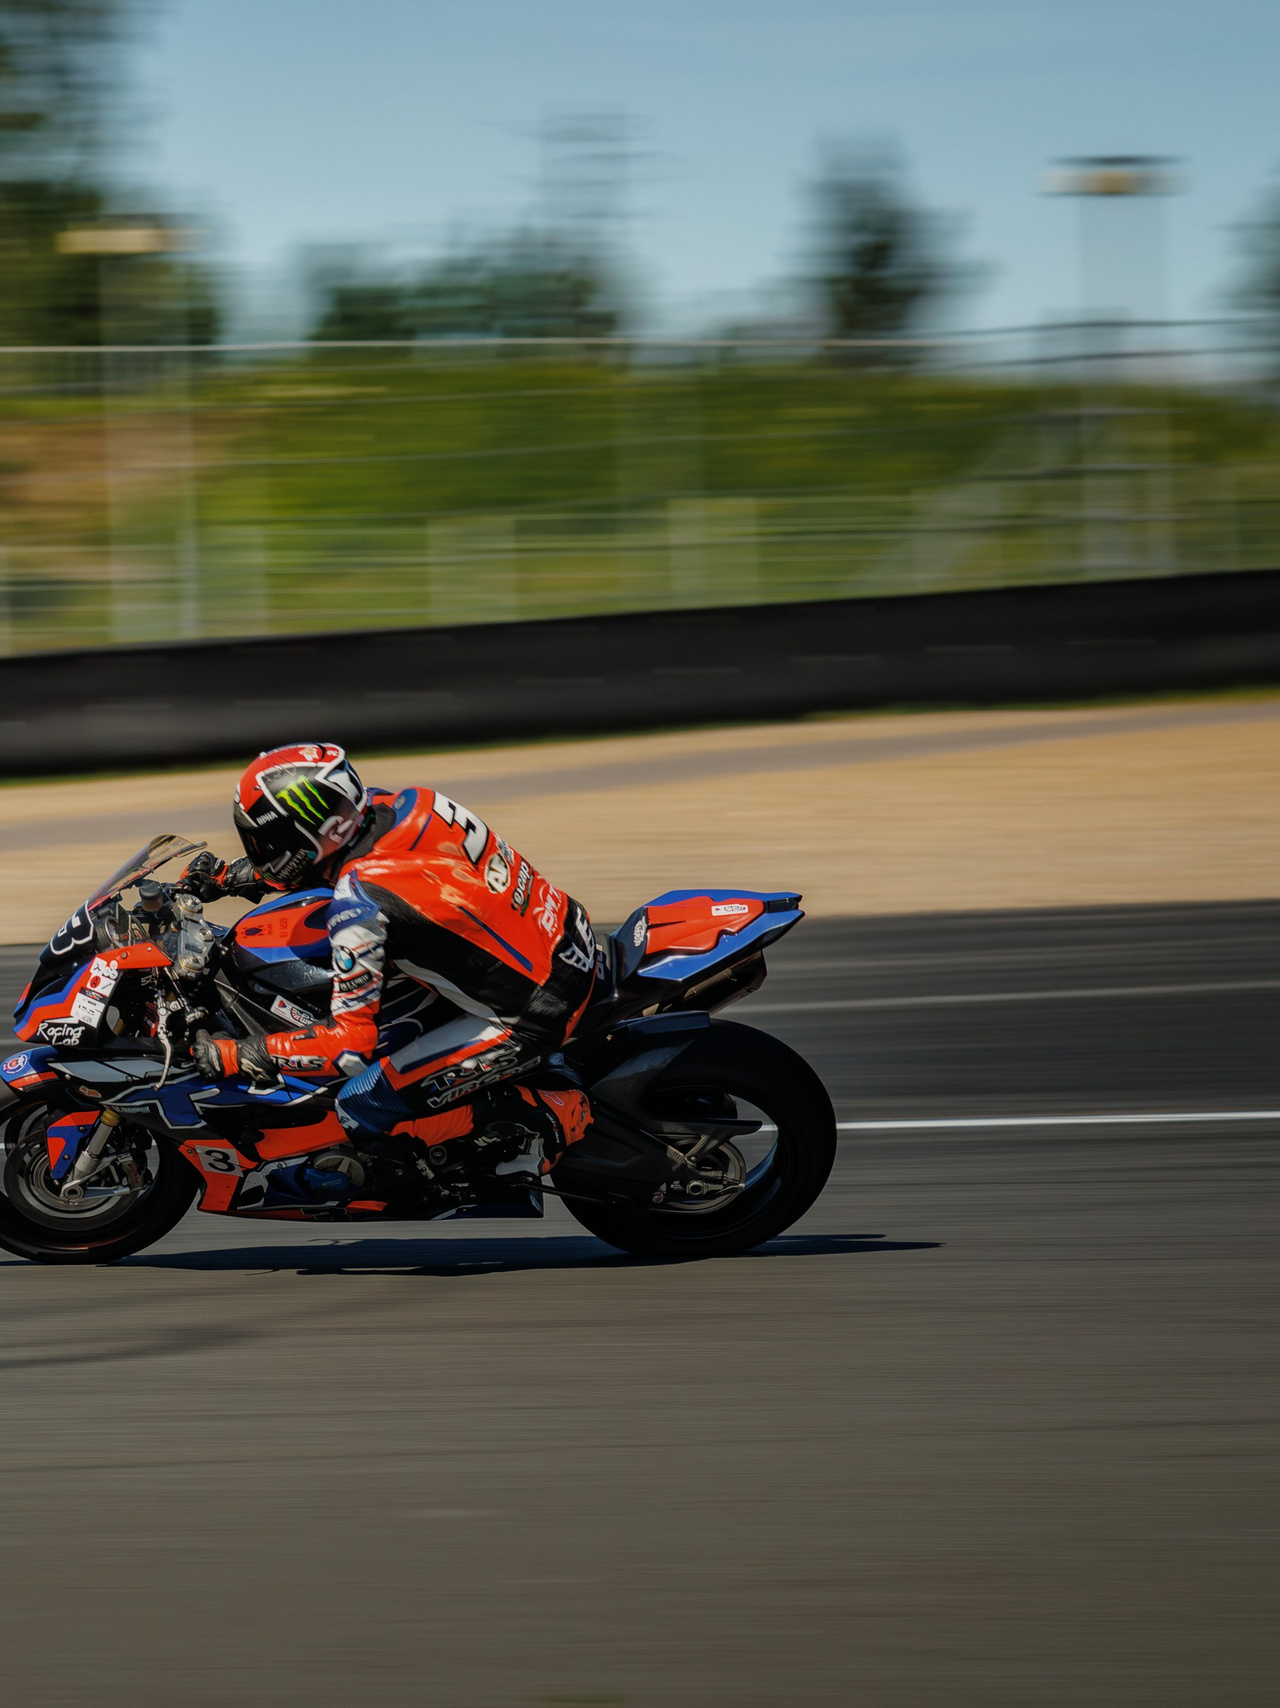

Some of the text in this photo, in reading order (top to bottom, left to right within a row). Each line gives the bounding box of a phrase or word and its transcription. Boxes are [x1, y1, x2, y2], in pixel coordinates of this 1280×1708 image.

[432, 789, 490, 871] 3
[36, 1022, 86, 1042] Racing
[51, 1032, 81, 1046] Lab
[205, 1149, 237, 1173] 3
